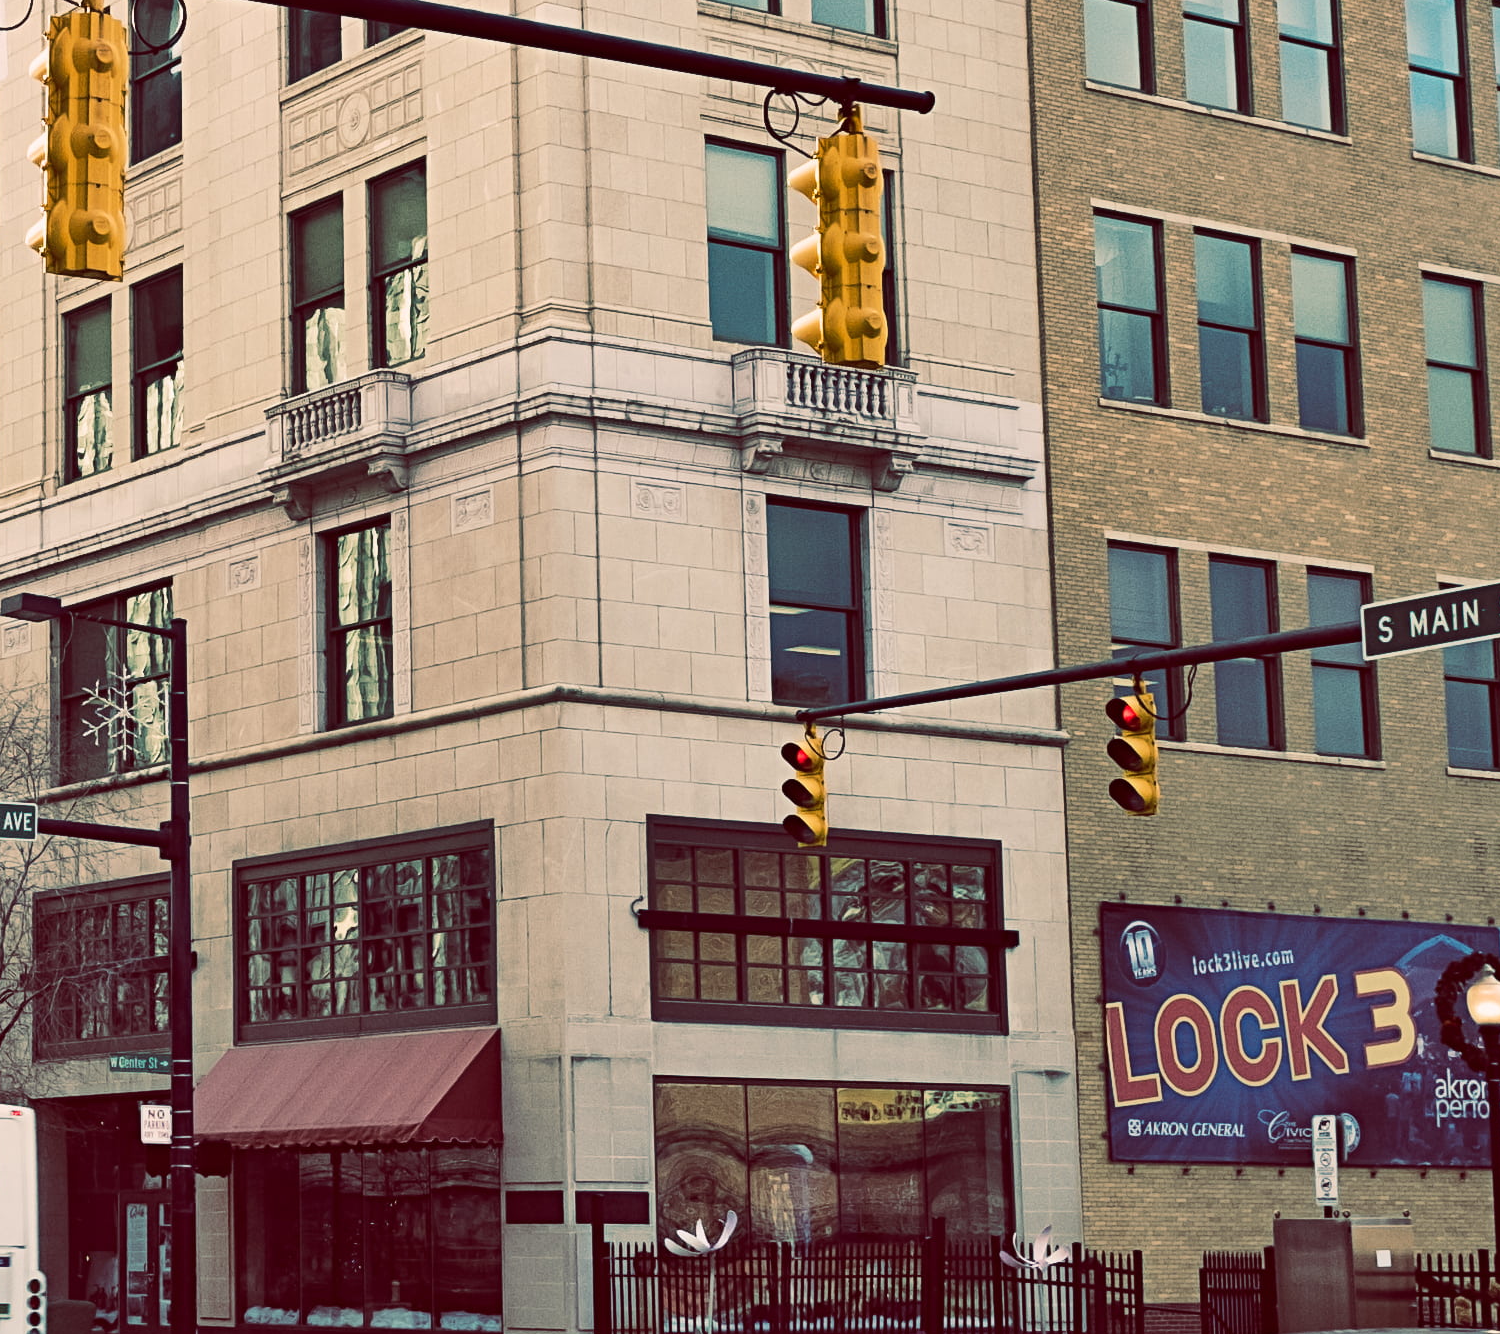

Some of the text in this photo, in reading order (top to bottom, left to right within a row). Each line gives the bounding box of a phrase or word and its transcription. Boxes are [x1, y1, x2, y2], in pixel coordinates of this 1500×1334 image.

[1377, 613, 1394, 644] S
[1409, 597, 1480, 638] MAIN
[2, 814, 33, 832] AVE
[1125, 929, 1156, 970] 10
[1191, 949, 1295, 976] lock3live.com
[1105, 967, 1418, 1108] LOCK 3
[110, 1056, 158, 1069] W Center St
[147, 1109, 165, 1120] NO
[1143, 1121, 1246, 1138] AKRON GENERAL
